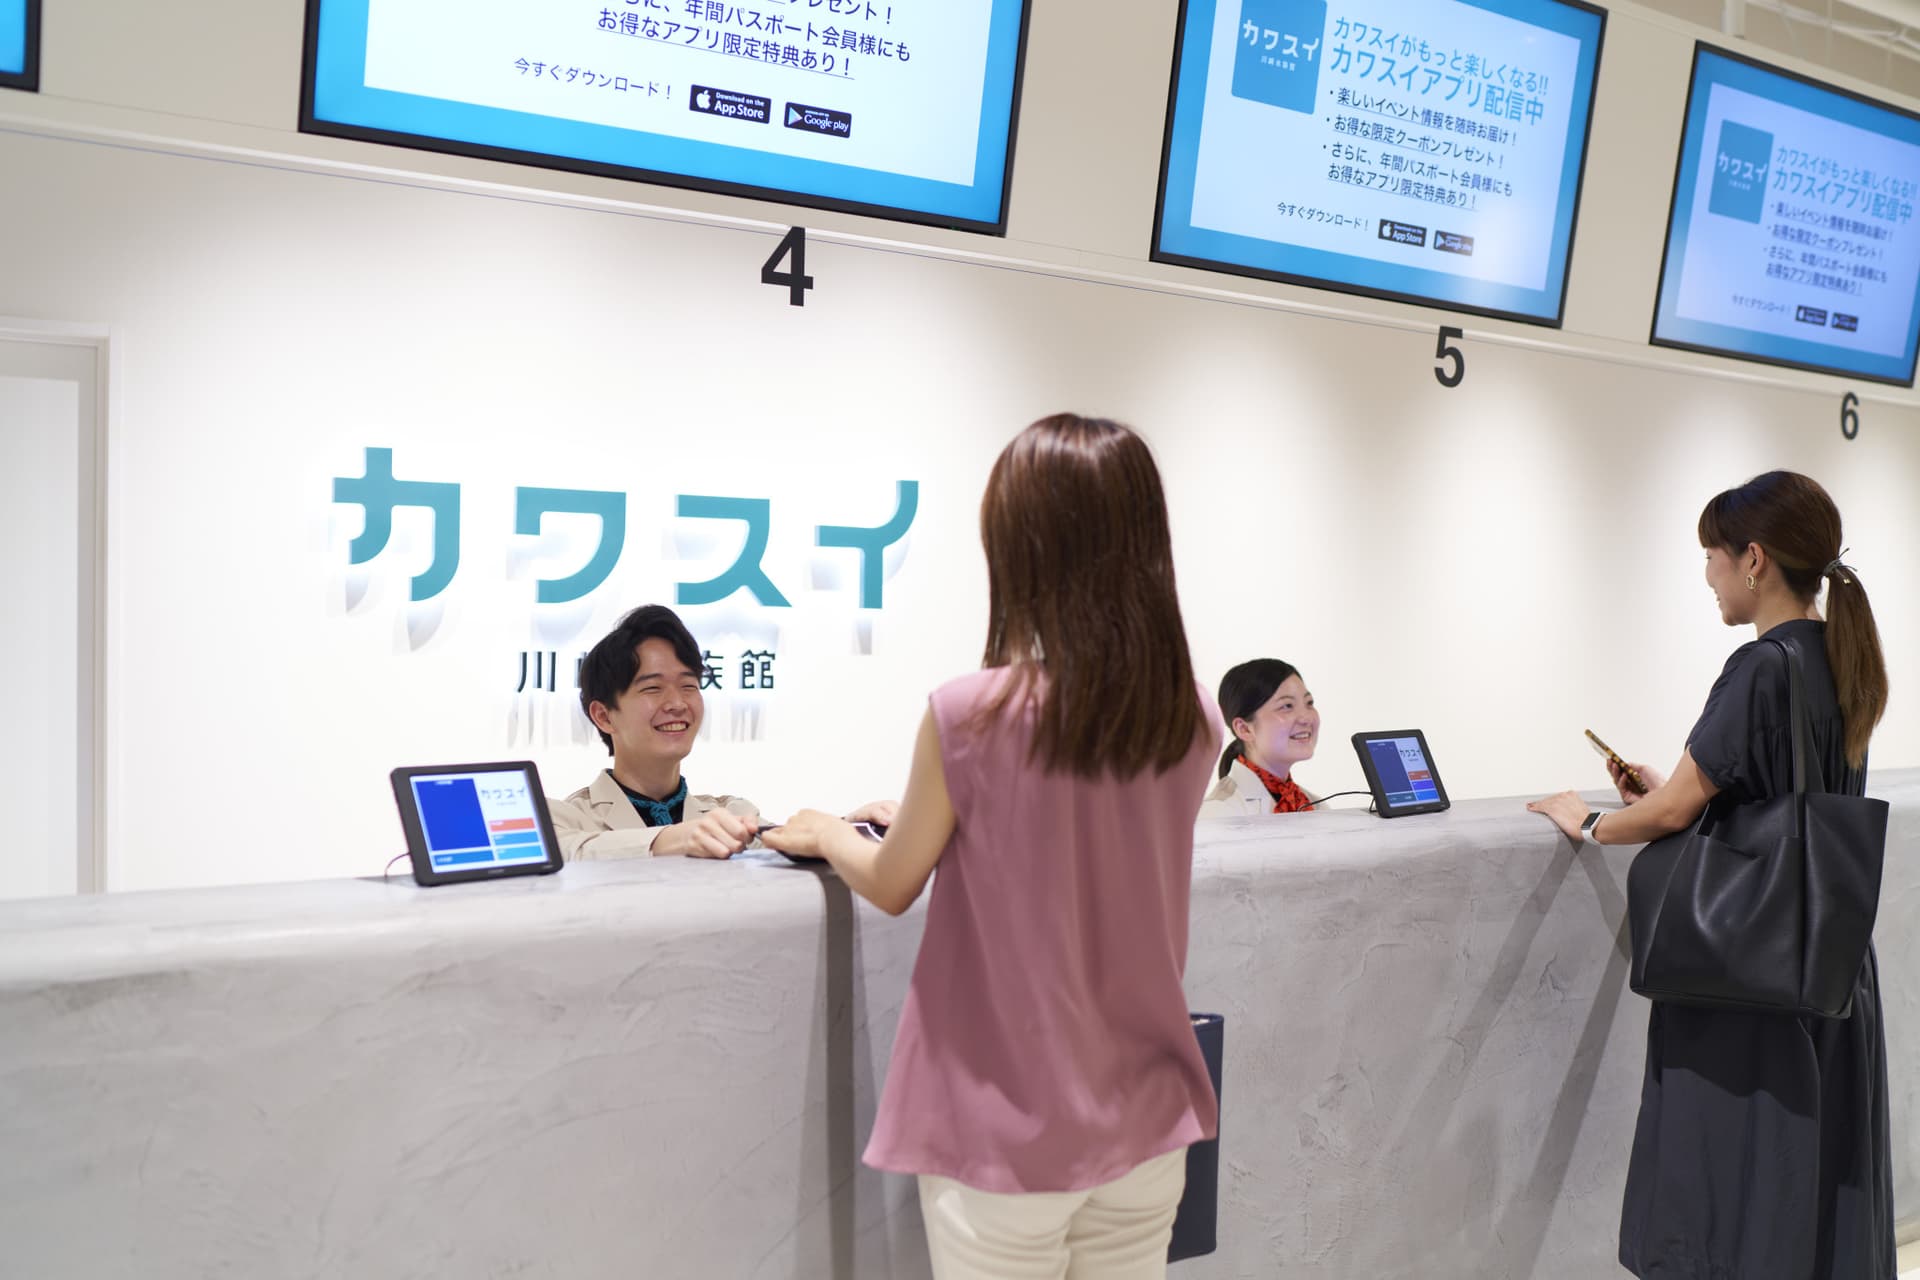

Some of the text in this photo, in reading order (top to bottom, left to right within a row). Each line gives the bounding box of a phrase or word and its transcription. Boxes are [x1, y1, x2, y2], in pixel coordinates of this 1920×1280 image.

[598, 8, 850, 76] お得なアプリ限定特典あり！
[1243, 19, 1320, 62] カワスイ
[514, 57, 671, 100] 今すぐダウンロード！
[1330, 43, 1545, 126] カワスイアプリ配信中
[714, 100, 765, 120] App Store
[804, 114, 849, 132] Google play
[1718, 151, 1767, 183] カワスイ
[761, 226, 814, 307] 4
[1434, 326, 1465, 388] 5
[1840, 391, 1859, 440] 6
[332, 446, 919, 609] カワスイ
[517, 649, 776, 693] 川族館
